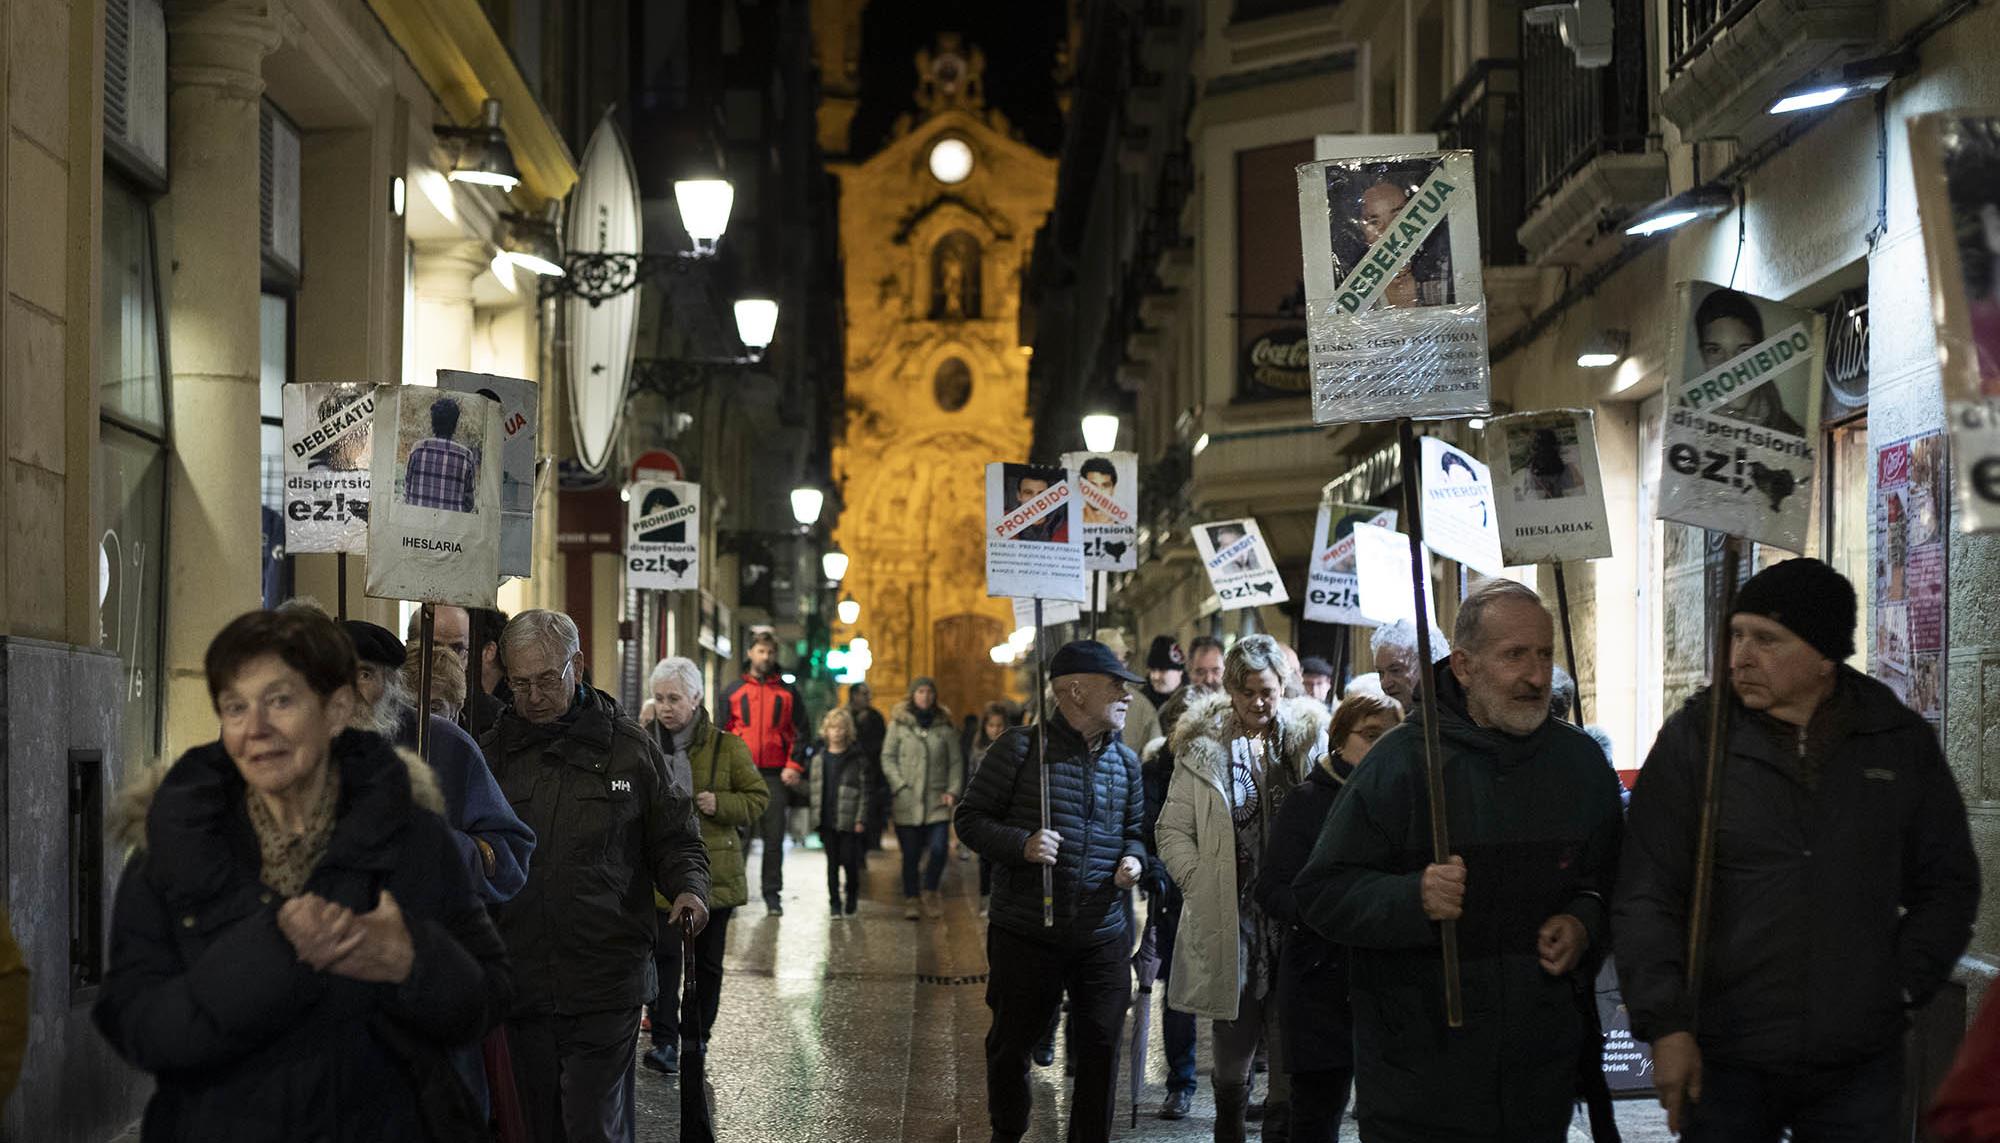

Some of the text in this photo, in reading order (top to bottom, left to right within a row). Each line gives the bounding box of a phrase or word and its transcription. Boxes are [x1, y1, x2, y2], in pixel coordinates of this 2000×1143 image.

[1337, 178, 1456, 314] DEBEKATUA
[1686, 330, 1809, 409] PROHIBIDO
[292, 398, 374, 458] DEBEKATU
[505, 412, 527, 436] UA
[1672, 410, 1813, 460] dispertsiorik
[288, 476, 371, 492] dispertsio
[288, 493, 345, 521] ez!
[995, 485, 1069, 536] PROHIBIDO
[1080, 482, 1128, 520] OHIBIDO
[632, 504, 696, 532] PROHIBIDO
[1515, 521, 1594, 537] IHESLARIAK
[402, 536, 463, 553] IHESLARIA
[1083, 537, 1101, 556] z!
[630, 555, 665, 572] ez!
[1220, 582, 1253, 600] ez!
[1310, 588, 1350, 608] ez!
[1604, 1040, 1634, 1050] ebida
